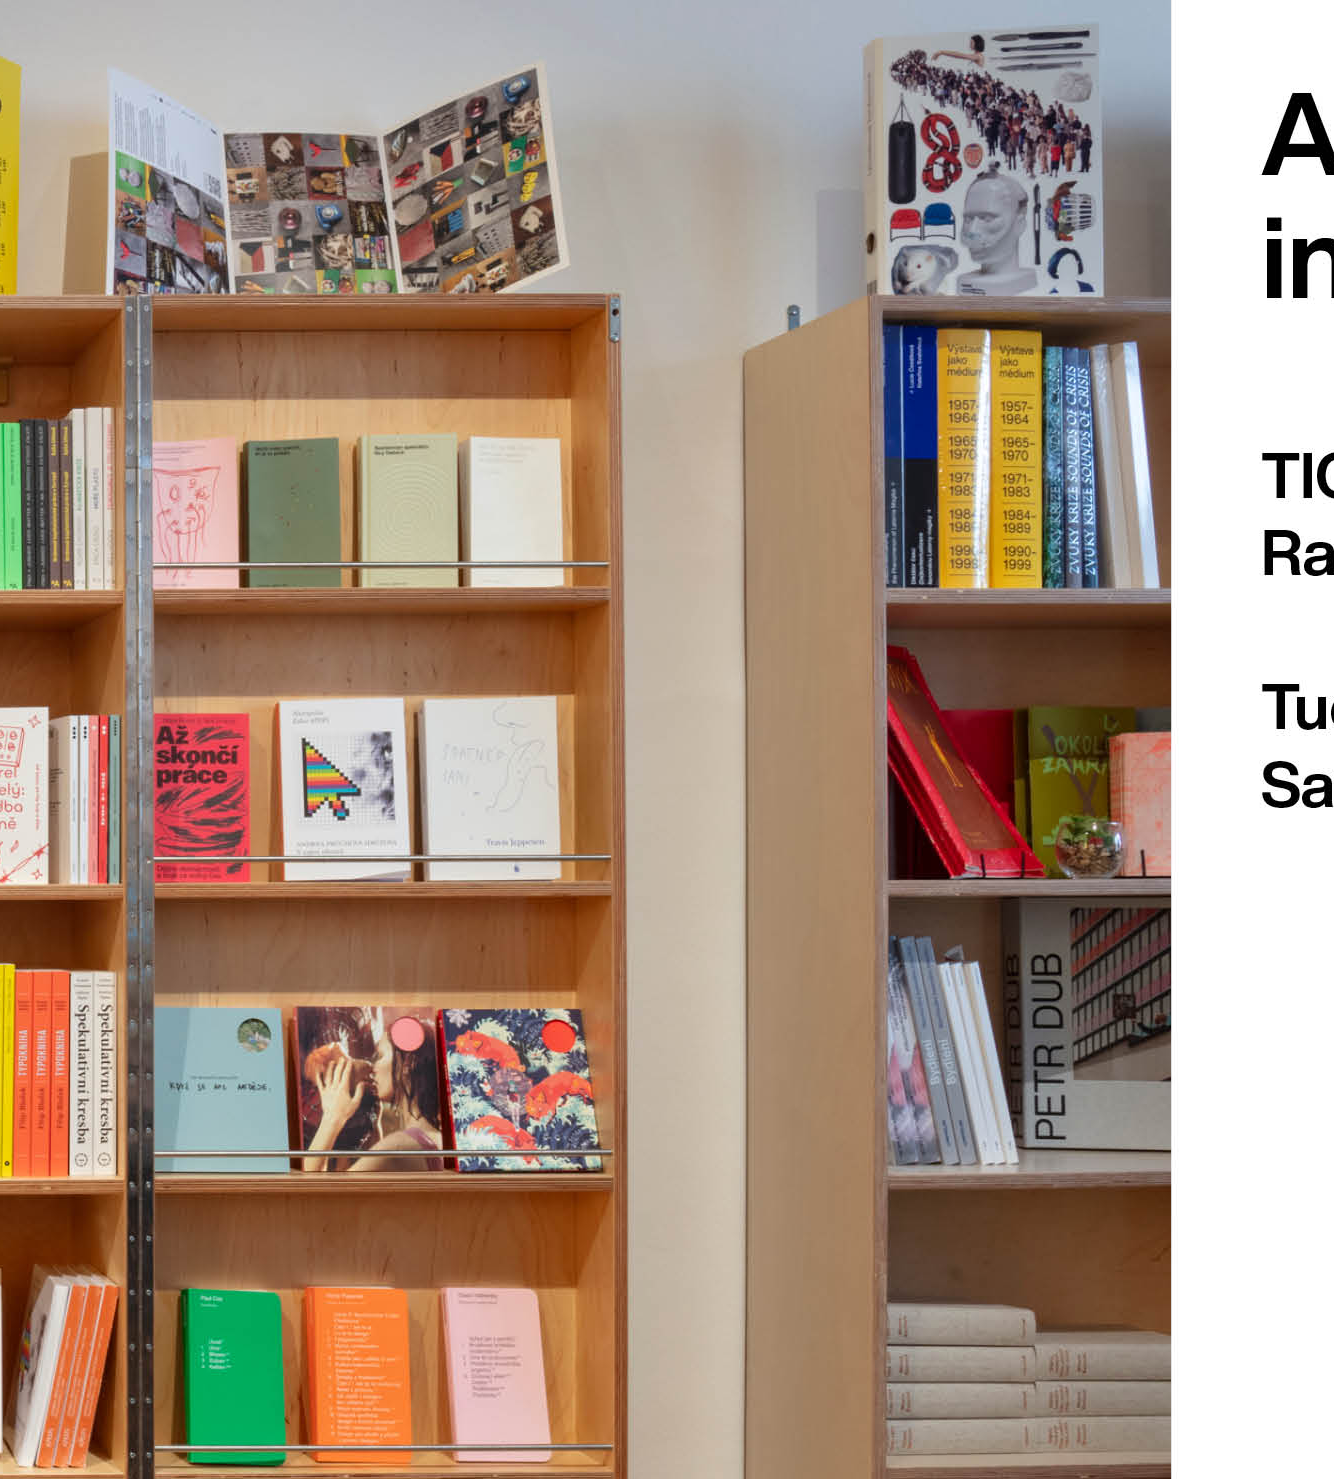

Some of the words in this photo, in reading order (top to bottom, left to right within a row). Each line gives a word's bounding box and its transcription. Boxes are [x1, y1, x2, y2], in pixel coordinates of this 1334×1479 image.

[947, 355, 968, 368] jako
[999, 344, 1035, 356] Výstava
[999, 356, 1019, 369] jako
[999, 368, 1035, 379] médium
[1065, 364, 1077, 406] CRISIS
[1078, 367, 1089, 408] CRISIS
[1001, 413, 1029, 425] 1964
[1066, 409, 1077, 426] OF
[1079, 410, 1090, 428] OF
[1002, 450, 1029, 461] 1970
[1067, 428, 1078, 482] SOUNDS
[1081, 431, 1092, 485] SOUNDS
[1002, 485, 1031, 498] 1983
[1068, 486, 1079, 524] KRIZE
[1083, 487, 1094, 526] KRIZE
[1002, 522, 1031, 534] 1989
[1003, 559, 1032, 570] 1999
[1068, 527, 1080, 575] ZVUKY
[1084, 529, 1096, 576] ZVUKY
[156, 725, 189, 745] Až
[1055, 736, 1109, 756] OKOL
[156, 745, 239, 766] skončí
[156, 766, 228, 788] práce
[1031, 953, 1064, 1029] DUB
[18, 1029, 28, 1077] TYPOKNIHA
[36, 1029, 47, 1077] TYPOKNIHA
[55, 1029, 66, 1077] TYPOKNIHA
[74, 1004, 90, 1095] Spekulativní
[97, 1003, 114, 1095] Spekulativní
[922, 1039, 940, 1086] Bydlení
[939, 1039, 957, 1086] Bydlení
[1033, 1044, 1067, 1140] PETR
[76, 1097, 90, 1145] kresba
[100, 1097, 114, 1144] kresba
